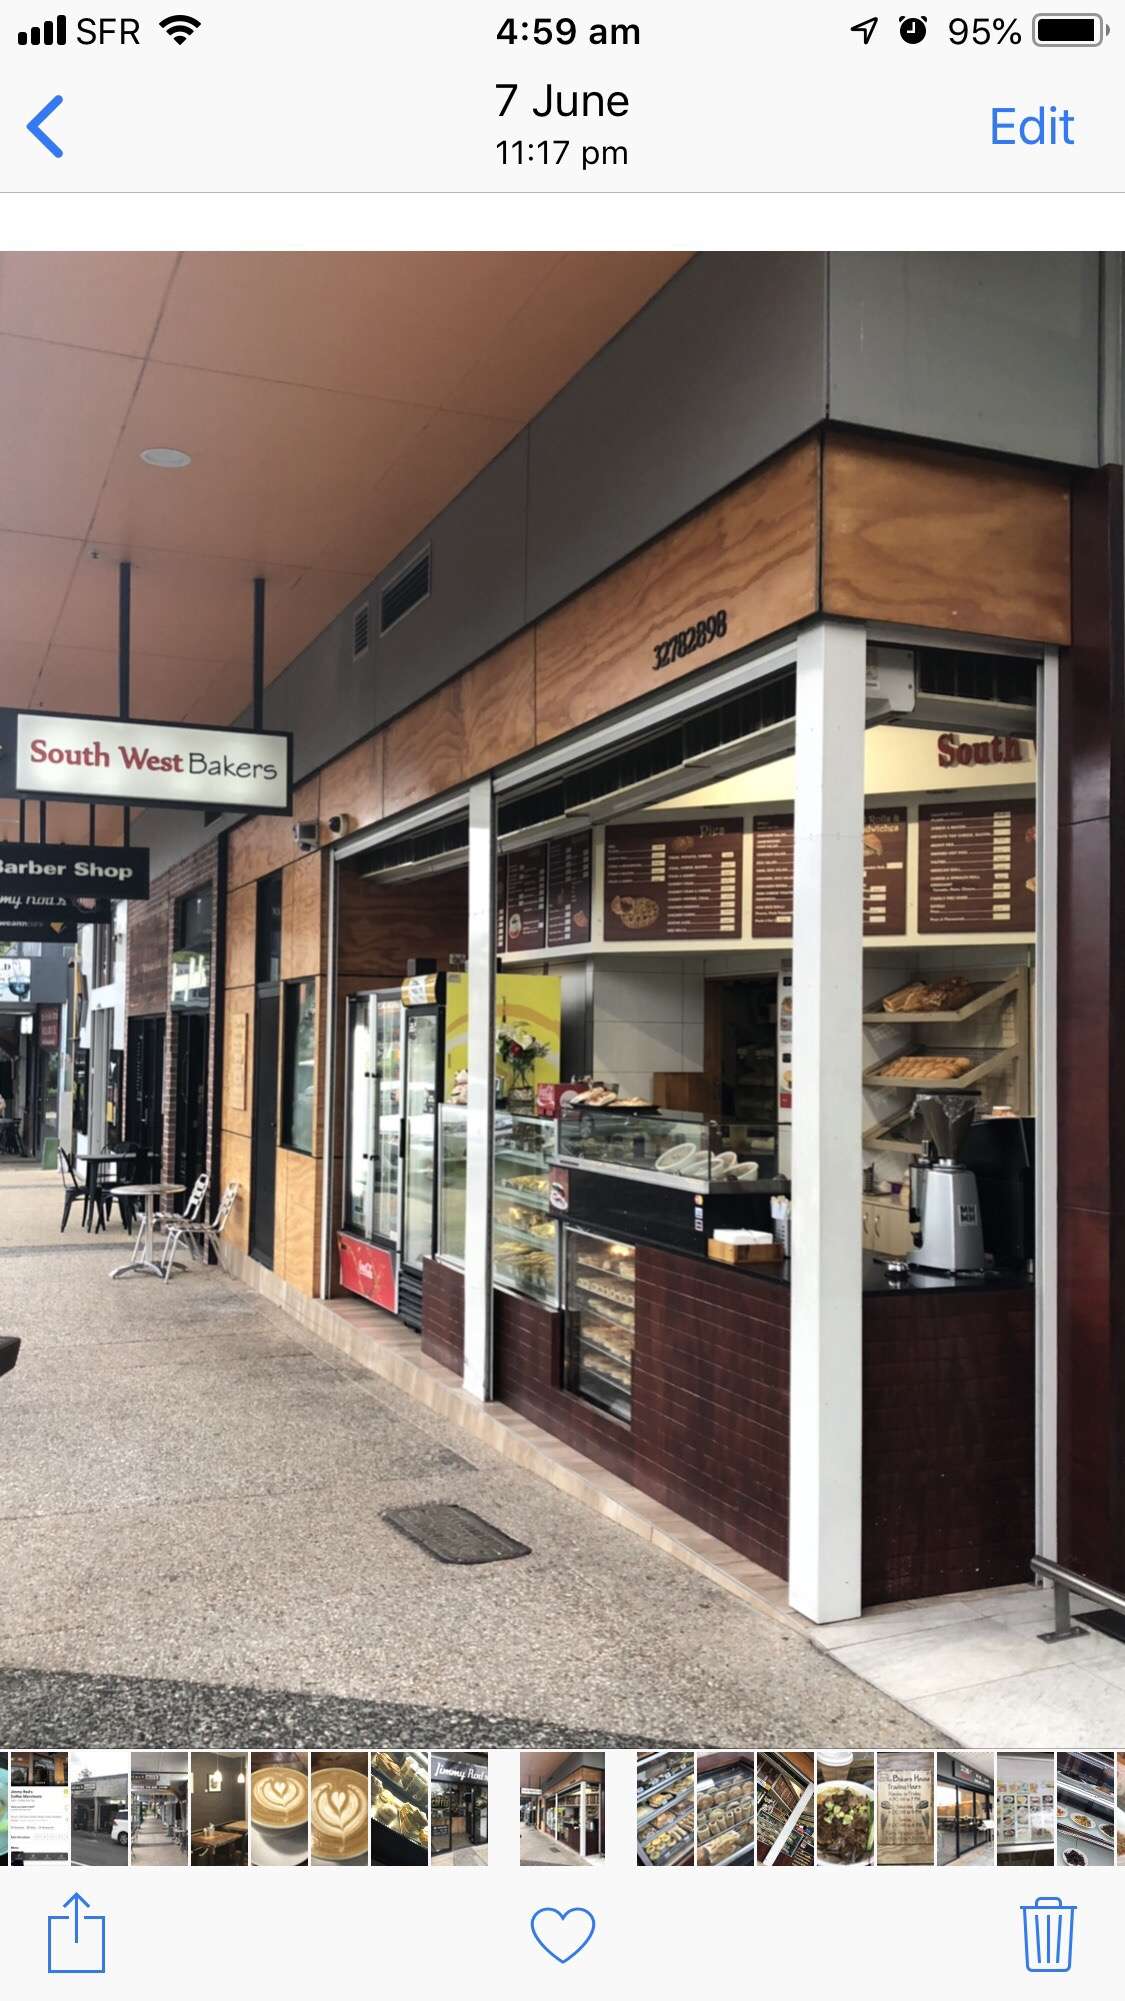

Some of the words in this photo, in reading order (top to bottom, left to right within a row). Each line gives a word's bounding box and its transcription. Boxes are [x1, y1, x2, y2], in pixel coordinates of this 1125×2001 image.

[652, 609, 727, 671] 32782898
[30, 739, 110, 768] South
[118, 745, 184, 774] West
[188, 753, 278, 780] Bakers
[938, 733, 1024, 768] South
[73, 861, 133, 881] Shop
